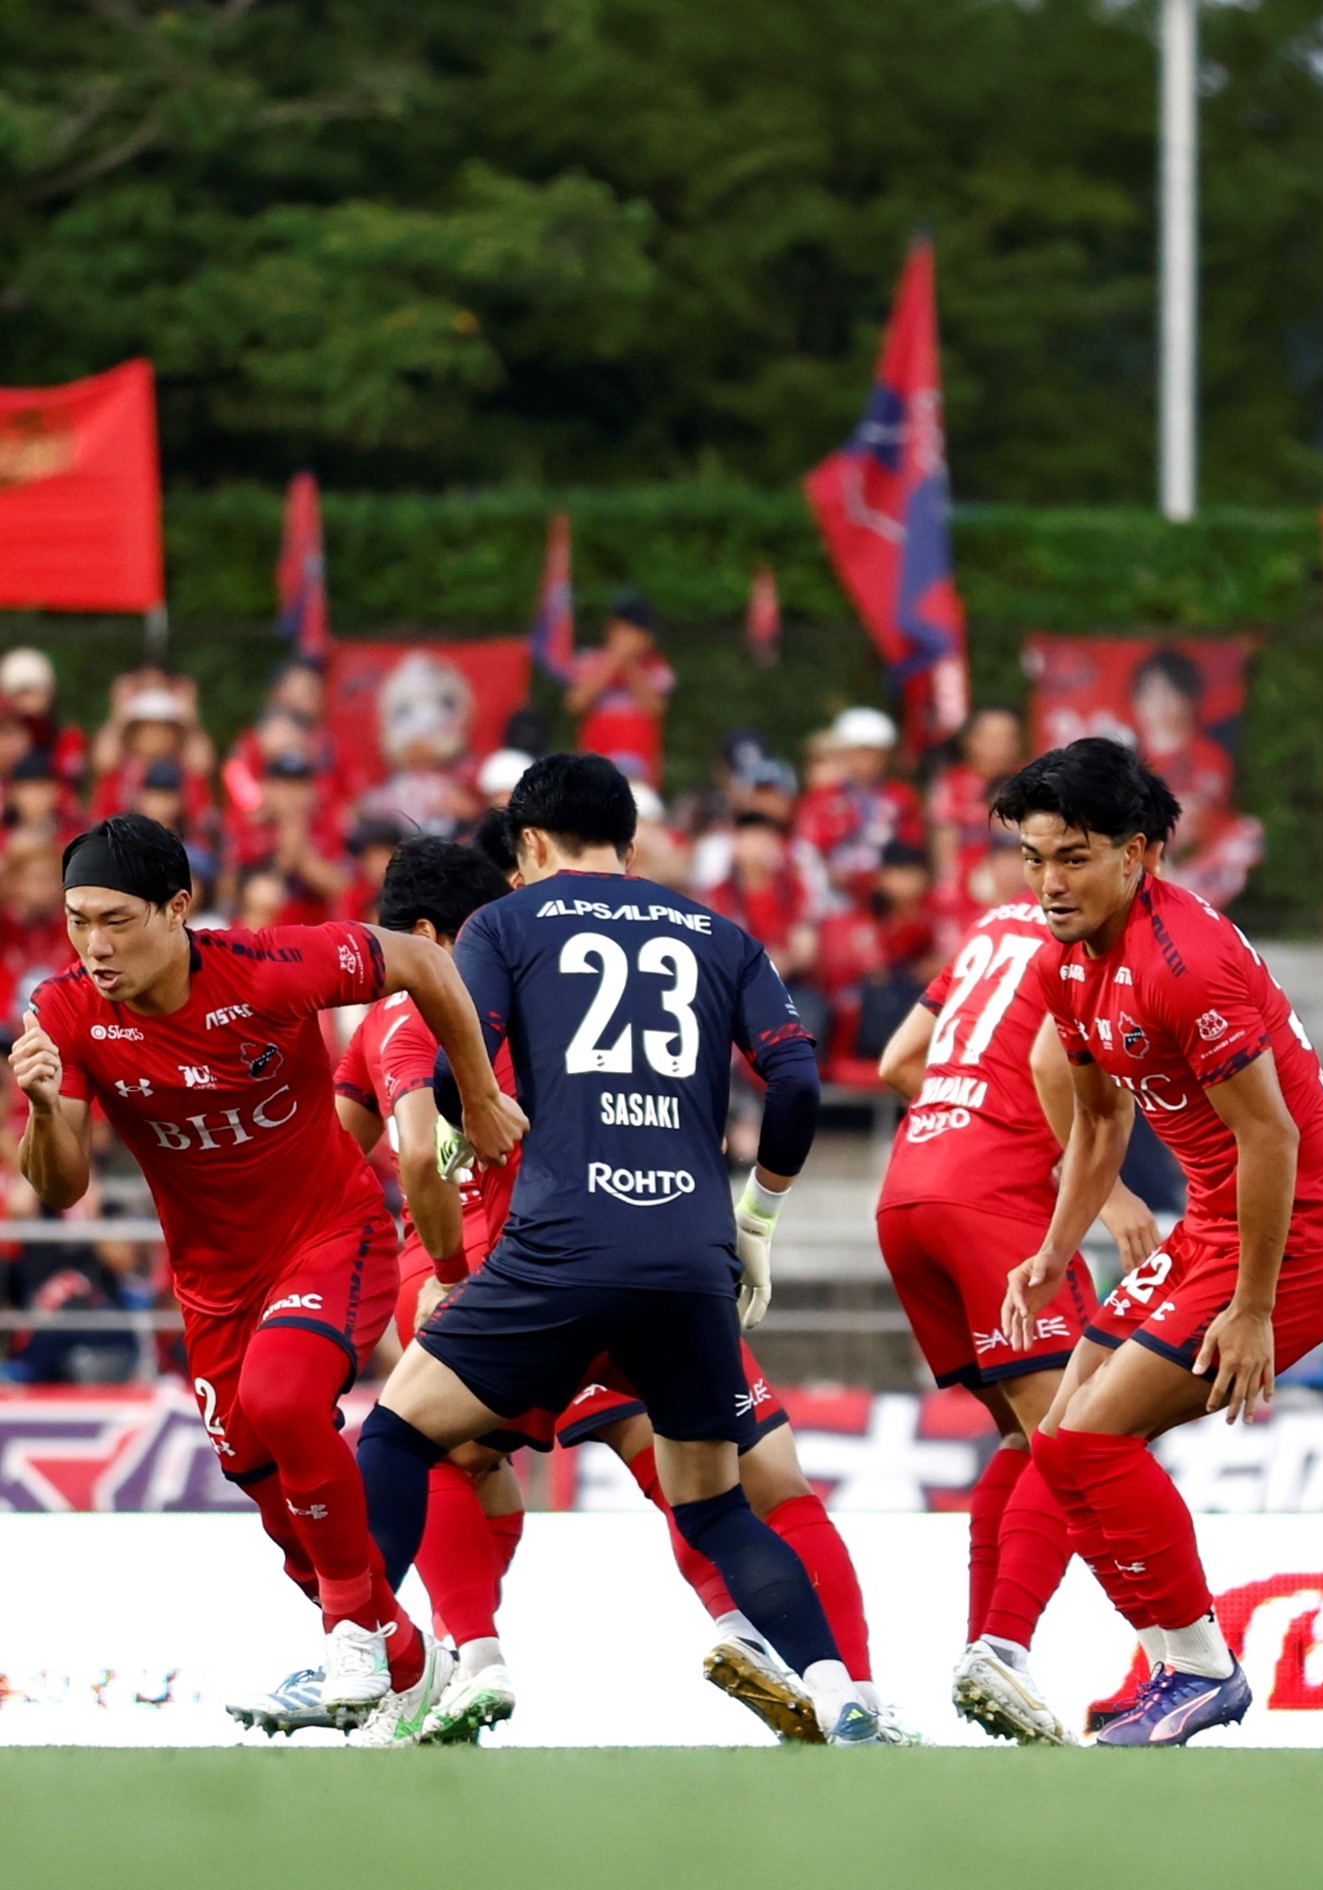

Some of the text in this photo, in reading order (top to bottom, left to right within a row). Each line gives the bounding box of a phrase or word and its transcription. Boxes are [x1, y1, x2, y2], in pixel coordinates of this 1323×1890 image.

[536, 899, 712, 935] ALPSALPINE
[559, 932, 700, 1078] 23
[926, 933, 1043, 1068] 27
[144, 1084, 298, 1151] BHC
[600, 1091, 680, 1130] SASAKI
[588, 1161, 696, 1206] ROHTO
[193, 1376, 226, 1436] 2
